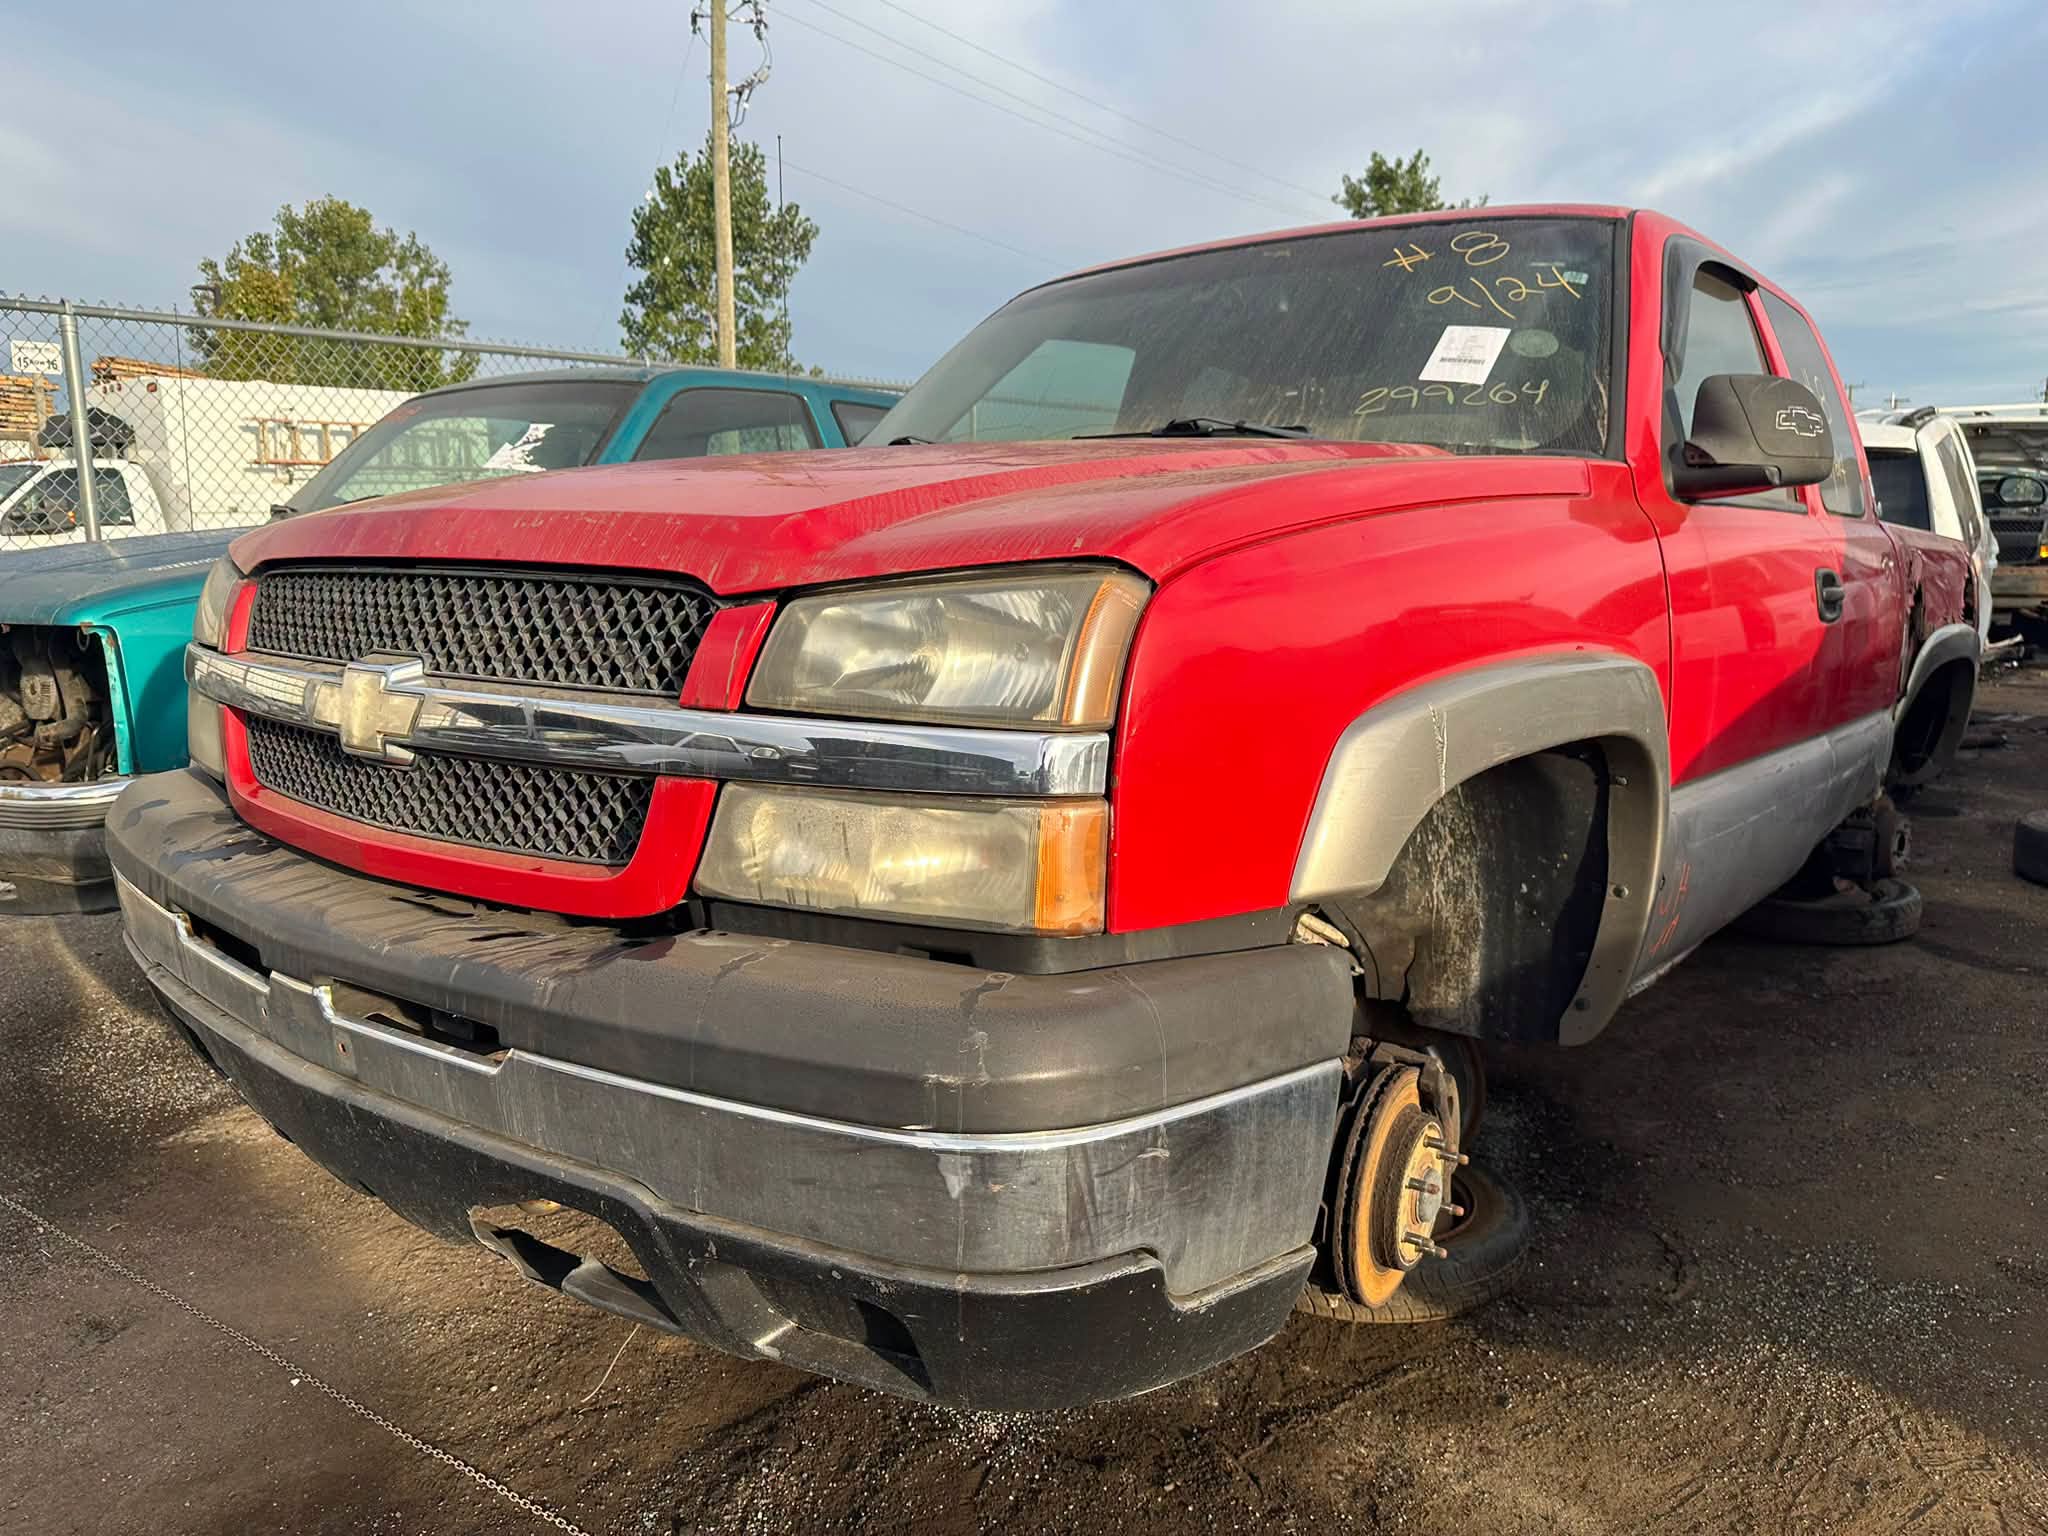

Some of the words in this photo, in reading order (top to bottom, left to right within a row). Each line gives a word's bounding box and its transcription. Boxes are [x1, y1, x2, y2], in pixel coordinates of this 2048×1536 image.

[1450, 231, 1510, 266] 8
[17, 356, 29, 369] 15
[46, 359, 58, 370] 16
[1353, 379, 1550, 416] 299264
